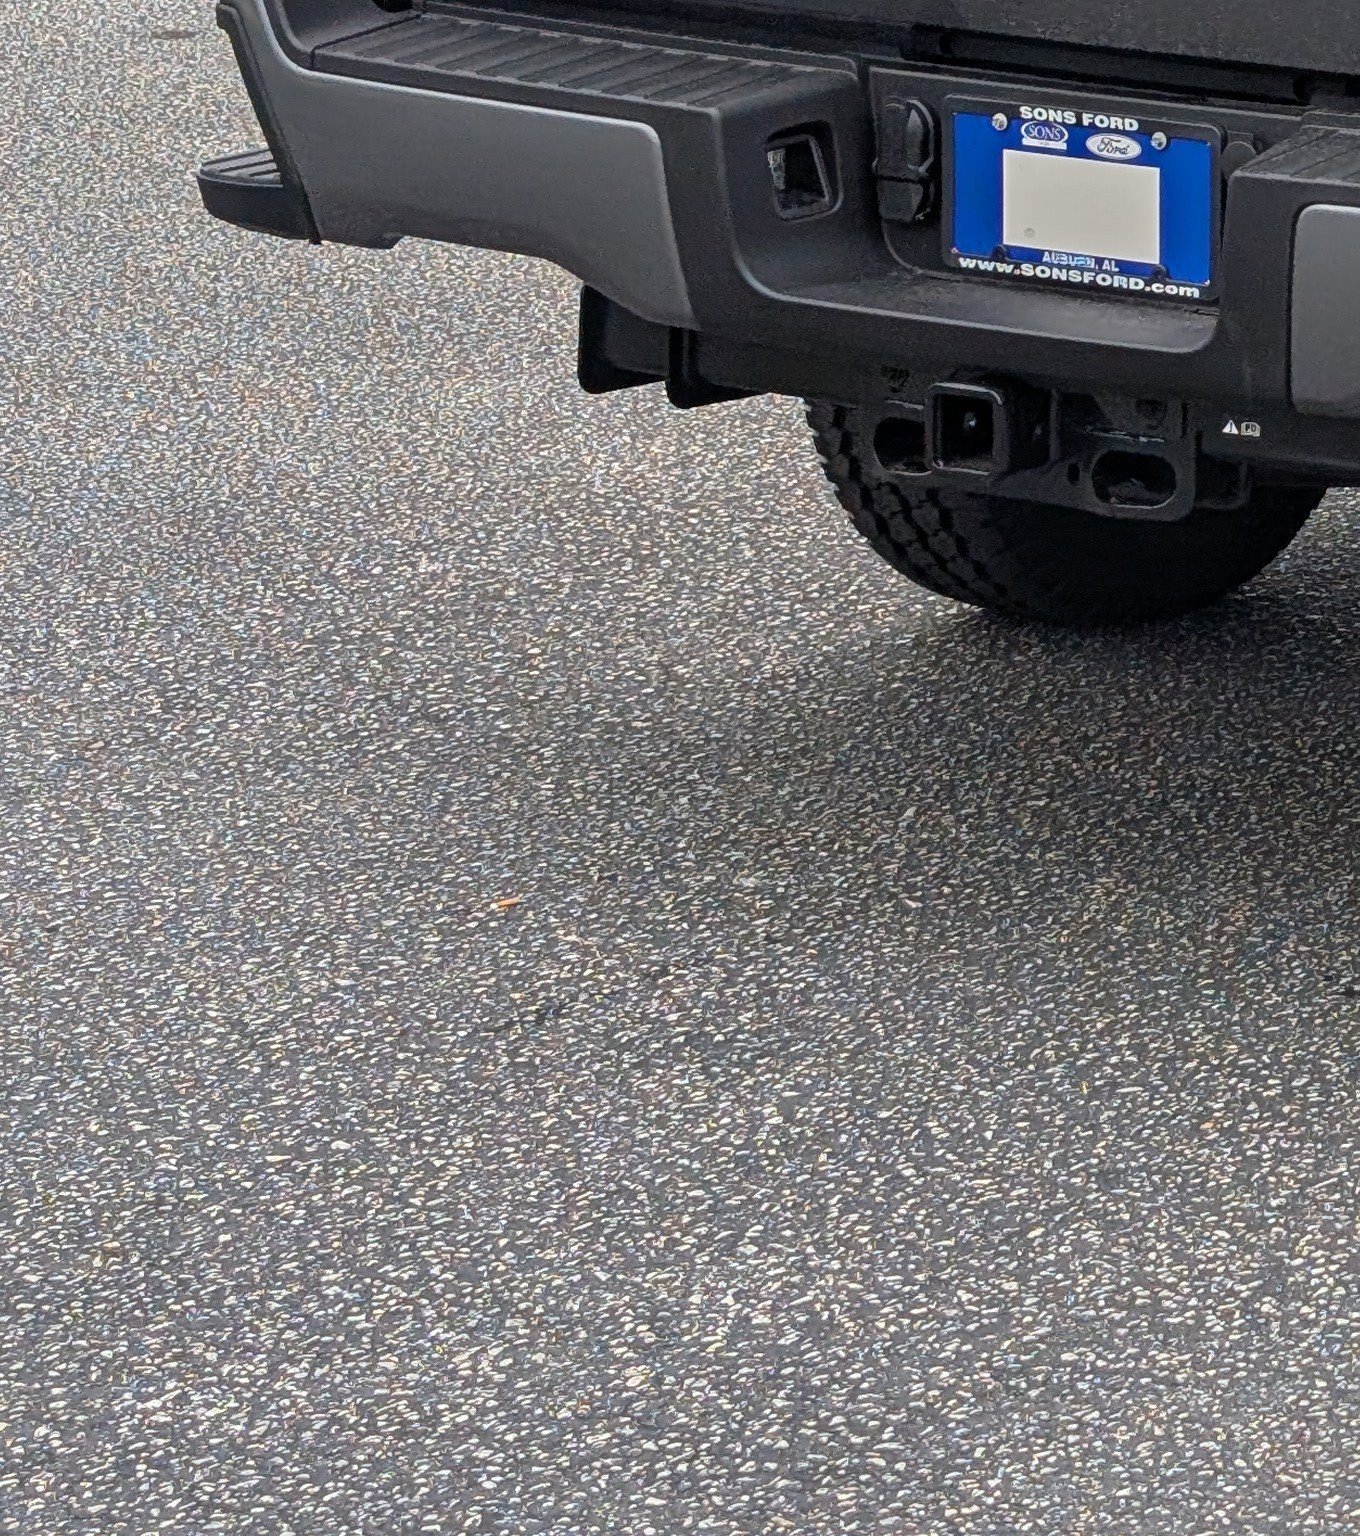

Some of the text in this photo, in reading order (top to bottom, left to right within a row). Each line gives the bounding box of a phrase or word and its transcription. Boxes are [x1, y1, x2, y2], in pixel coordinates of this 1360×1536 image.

[1019, 105, 1139, 132] SONS FORD
[1028, 124, 1061, 140] SONS
[1097, 136, 1129, 156] Ford
[1102, 259, 1120, 272] AL
[958, 257, 1200, 298] www.SONSFORD.com
